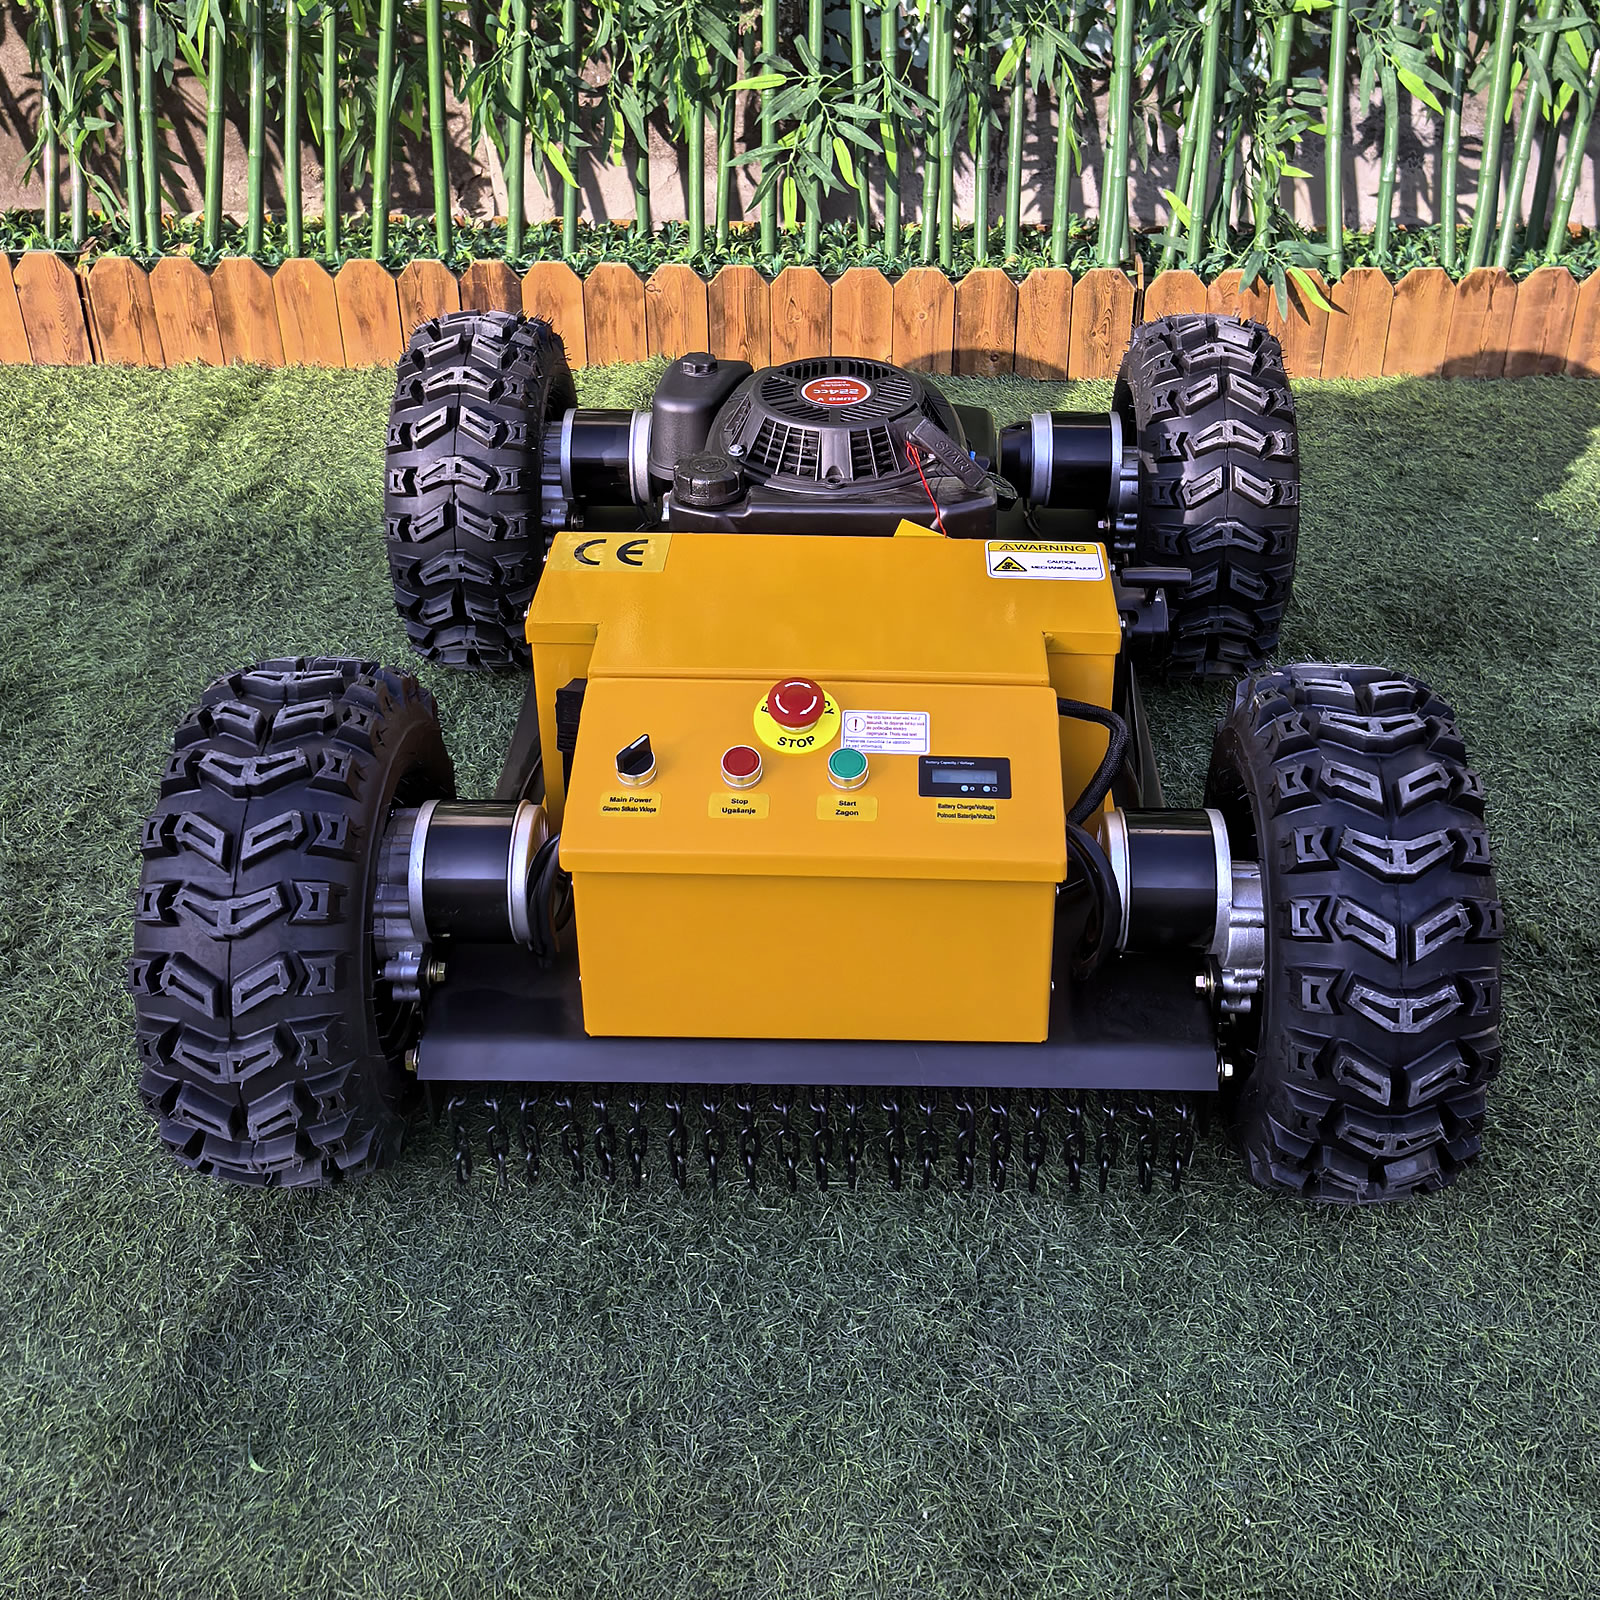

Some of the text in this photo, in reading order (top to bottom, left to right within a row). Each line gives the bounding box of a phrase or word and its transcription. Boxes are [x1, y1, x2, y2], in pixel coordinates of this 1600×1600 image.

[1014, 543, 1087, 552] WARNING
[573, 538, 649, 567] CE
[777, 735, 815, 748] STOP
[731, 798, 749, 806] Stop
[835, 809, 859, 817] Zagon
